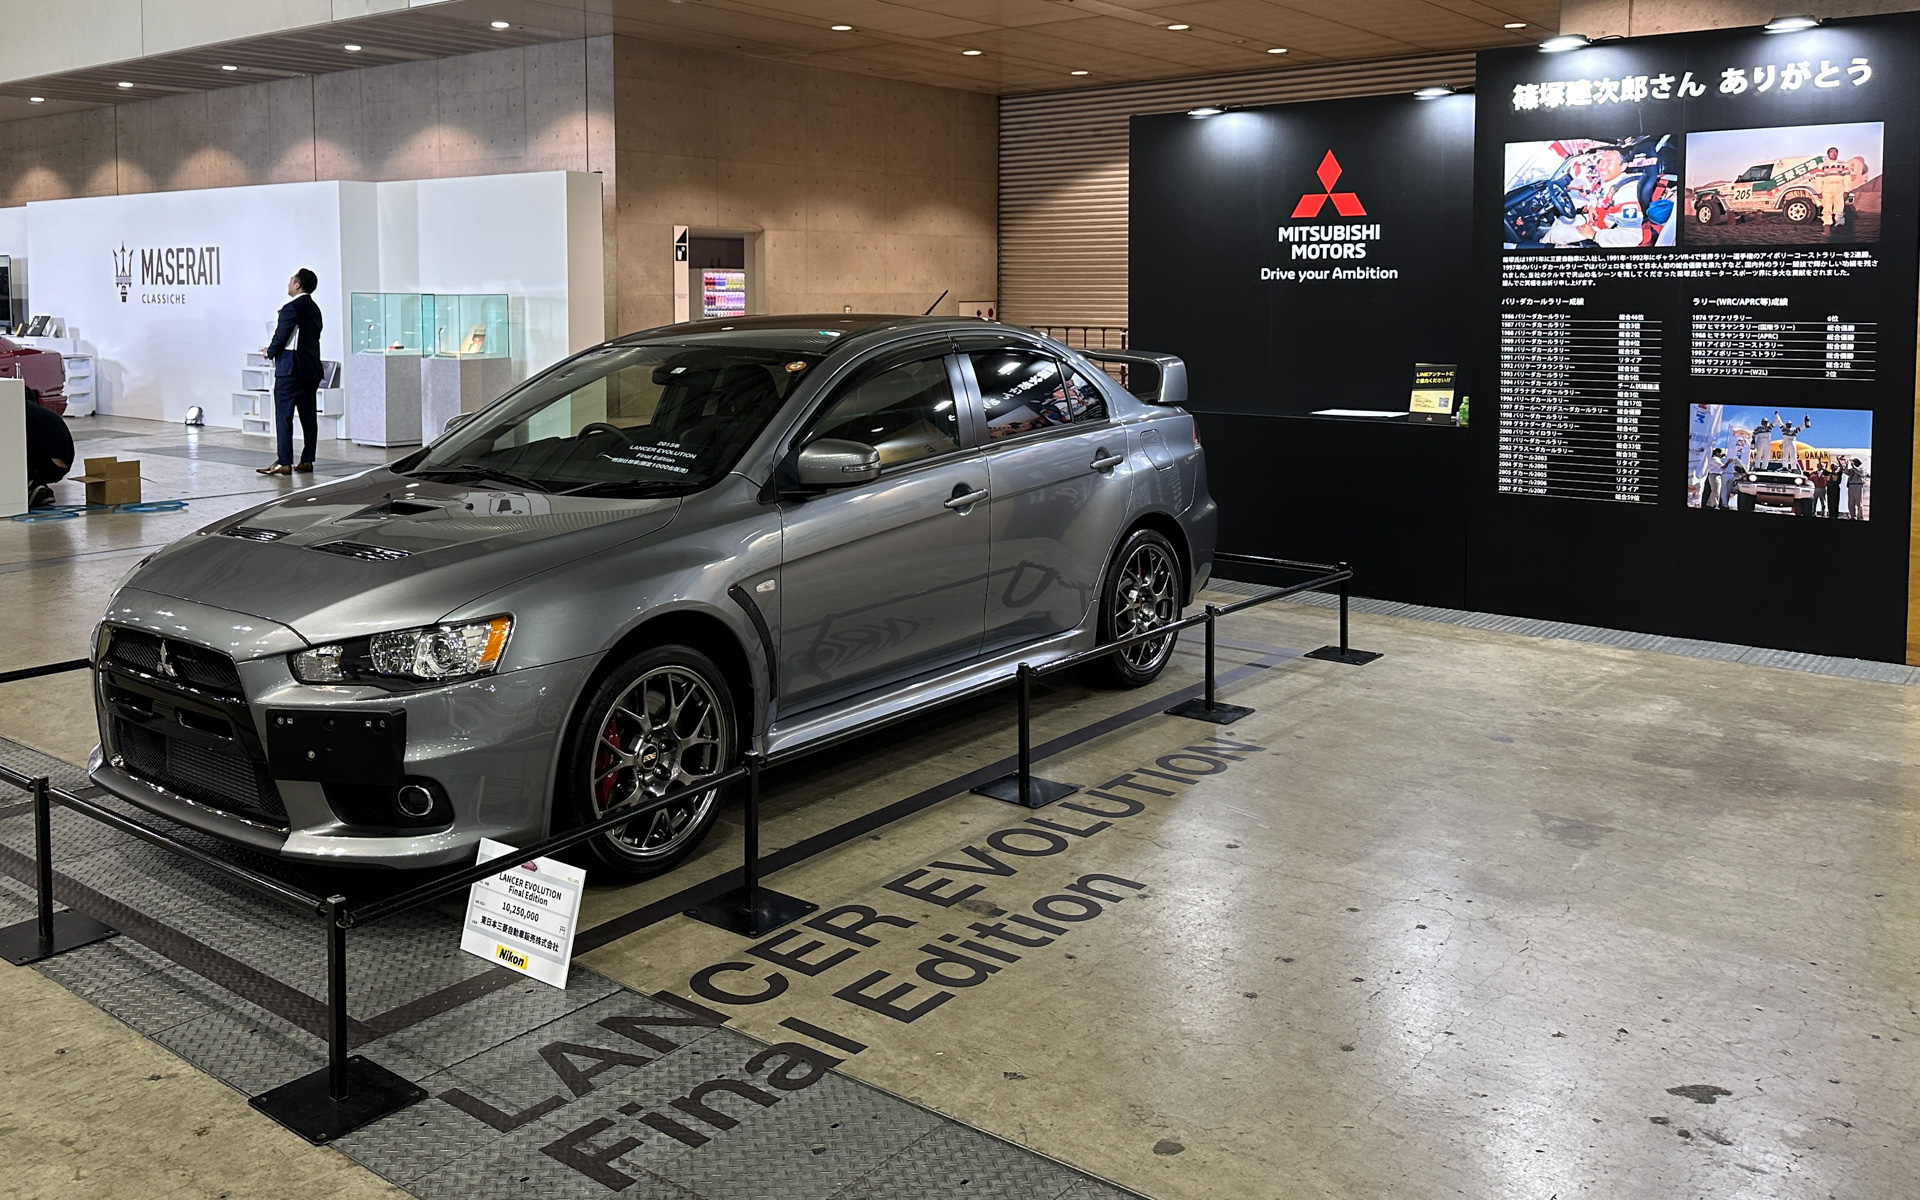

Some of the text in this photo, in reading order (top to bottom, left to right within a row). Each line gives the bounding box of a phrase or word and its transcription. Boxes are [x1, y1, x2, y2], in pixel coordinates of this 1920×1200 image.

[1719, 57, 1872, 95] ありがとう
[1734, 189, 1751, 200] 205
[1278, 224, 1381, 243] MITSUBISHI
[1291, 243, 1367, 260] MOTORS
[141, 247, 220, 285] MASERATI
[1260, 266, 1398, 283] Drive your Ambition
[142, 294, 185, 304] CLASSICHE
[1825, 361, 1851, 369] 総合2位
[629, 445, 698, 459] LANCER EVOLUTION
[635, 452, 676, 463] Final Edition
[1804, 451, 1829, 459] DAKAR
[1616, 459, 1640, 467] リタイア
[499, 872, 524, 887] LANCER
[524, 881, 562, 900] EVOLUTION
[508, 885, 548, 906] Final Edition
[502, 902, 566, 935] 10,250,000 円
[435, 736, 1267, 1133] LANCER EVOLUTION
[480, 915, 559, 952] 東日本三菱自動車販売株式会社
[499, 948, 525, 967] Nikon
[538, 872, 1147, 1193] Final Edition
